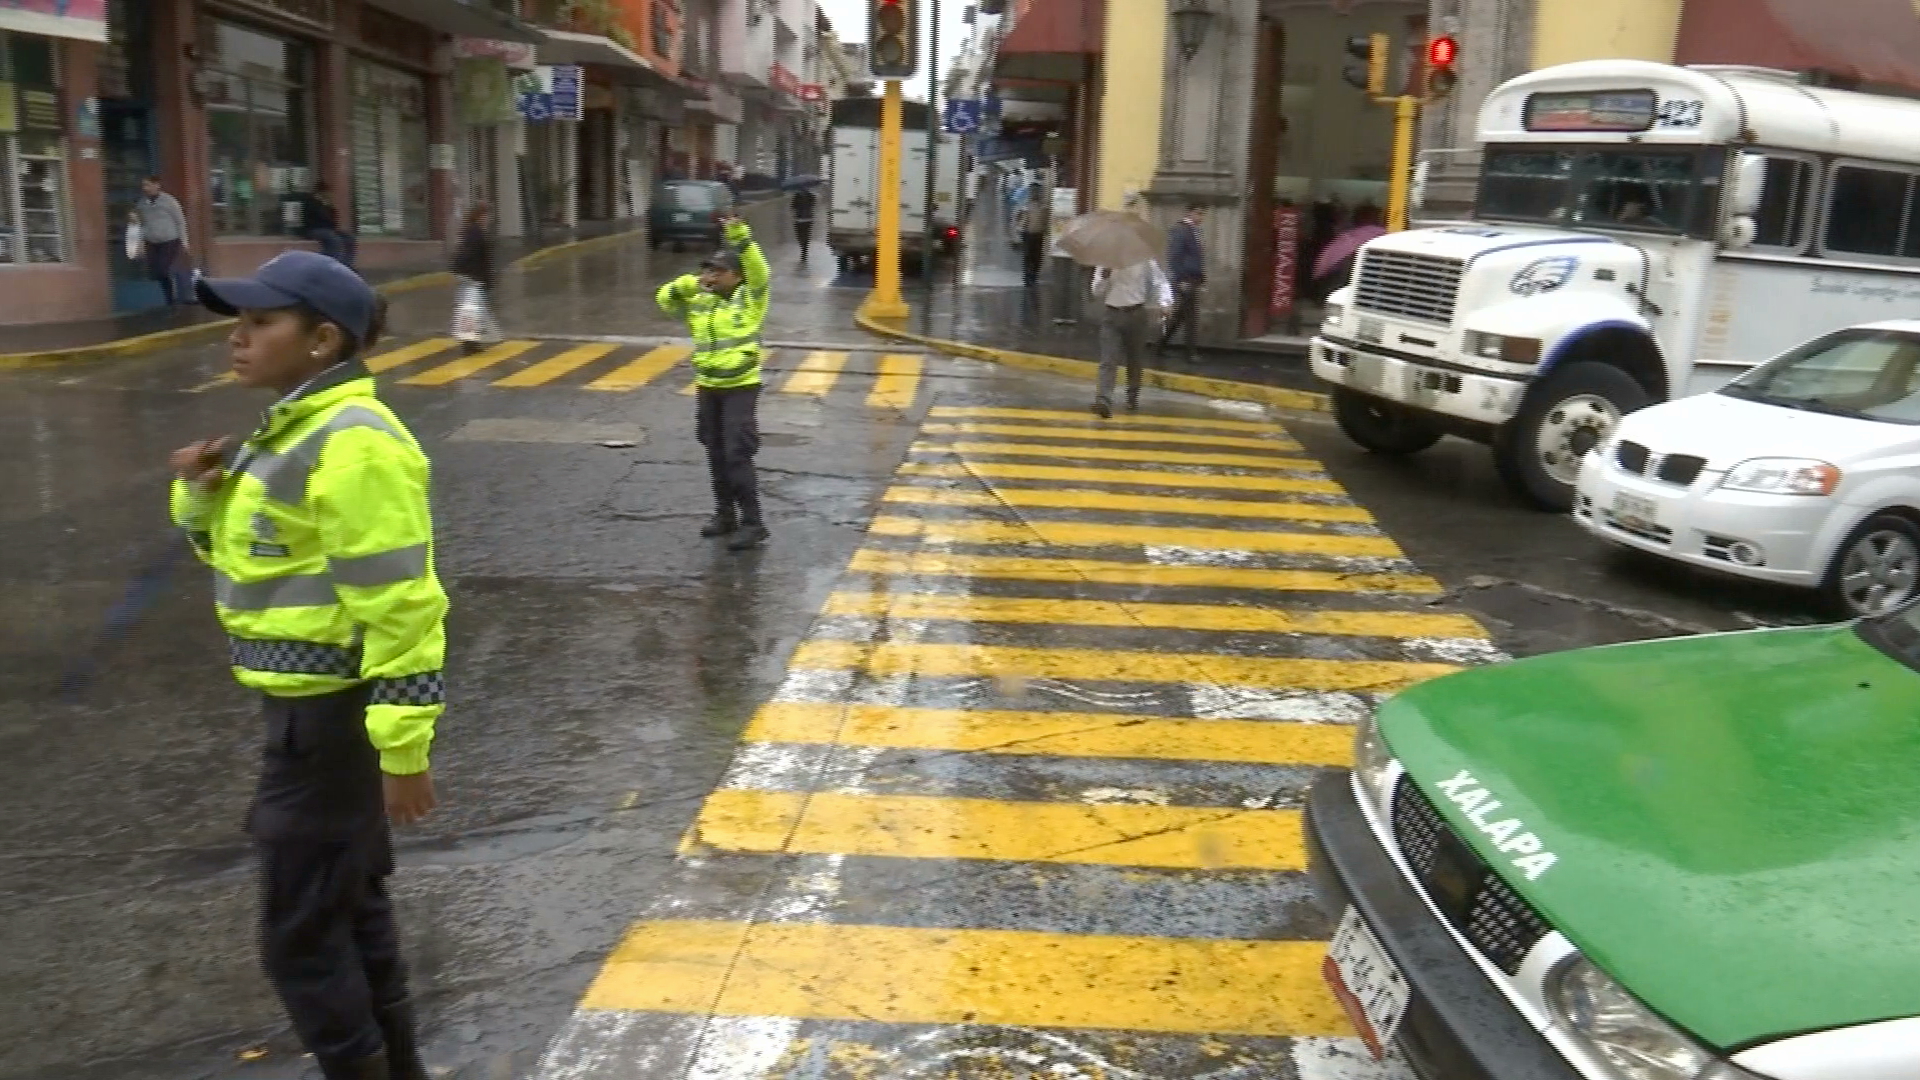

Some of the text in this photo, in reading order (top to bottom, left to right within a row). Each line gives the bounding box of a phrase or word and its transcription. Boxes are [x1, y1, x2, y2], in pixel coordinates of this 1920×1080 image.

[1658, 100, 1704, 128] 423
[1272, 212, 1296, 308] REBAJAS
[1433, 769, 1557, 882] XALAPA
